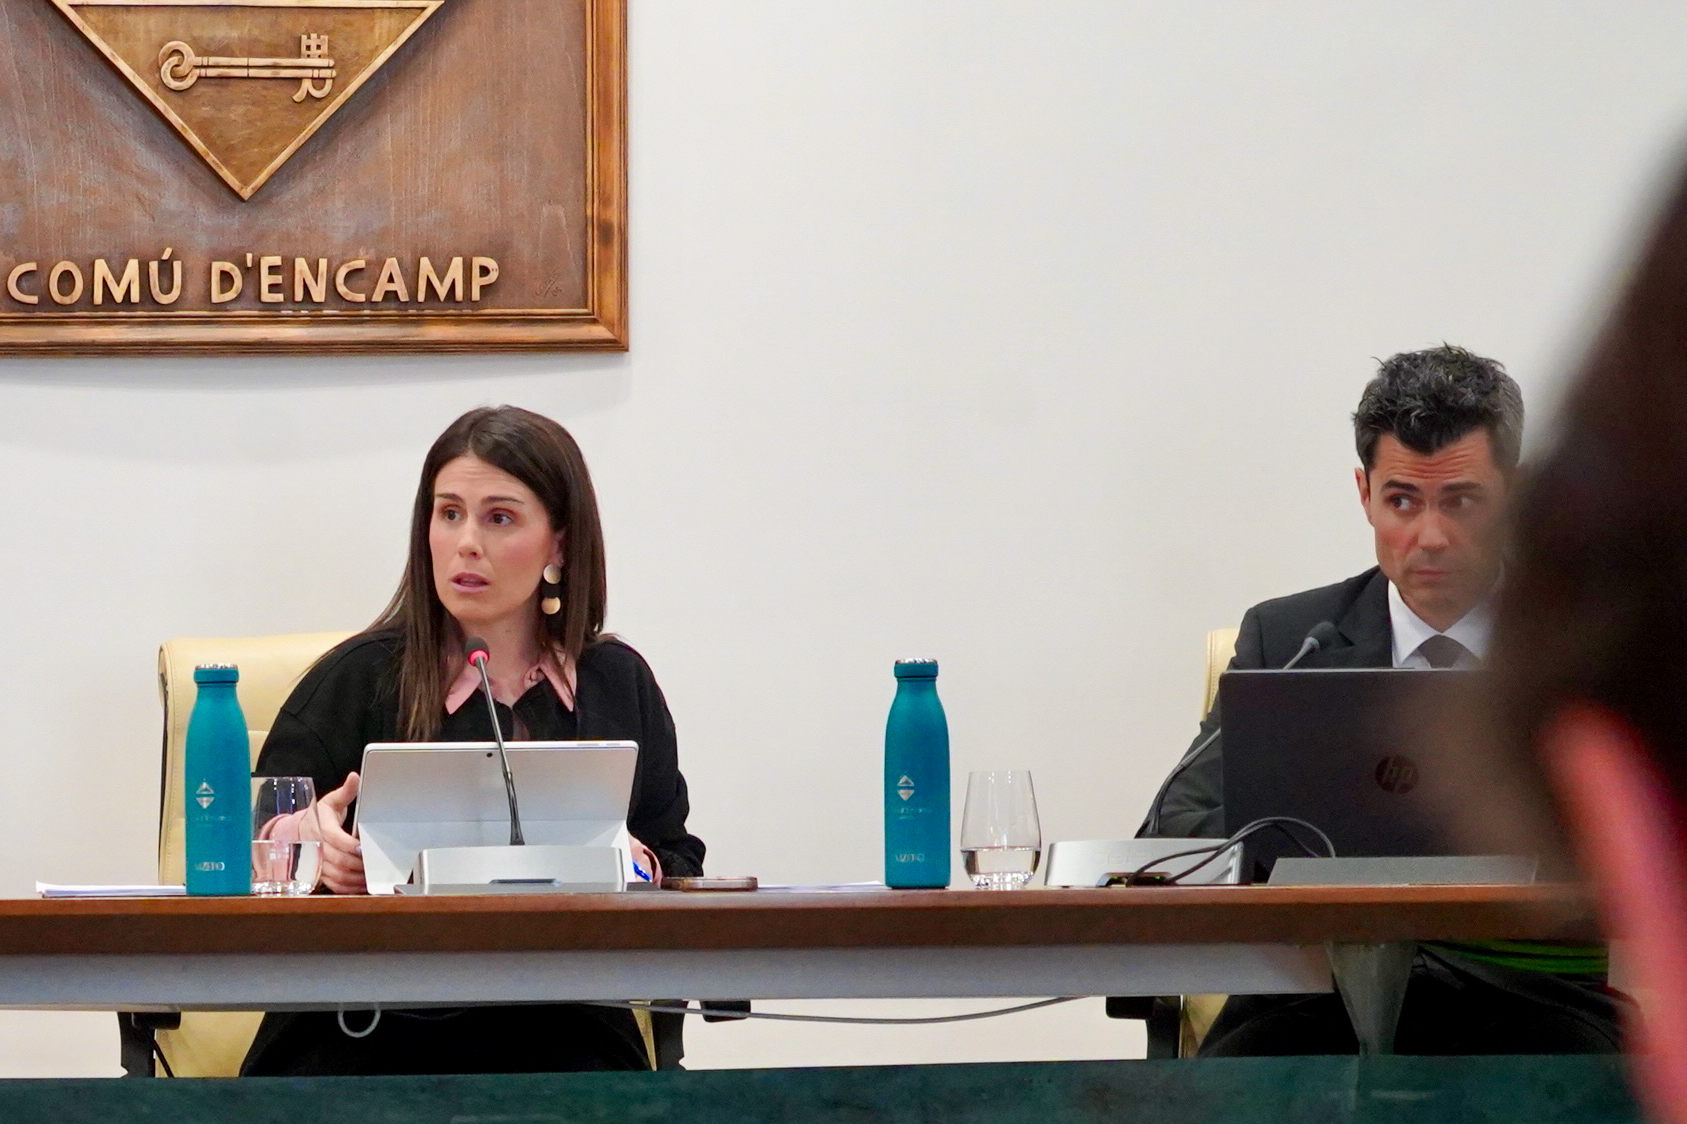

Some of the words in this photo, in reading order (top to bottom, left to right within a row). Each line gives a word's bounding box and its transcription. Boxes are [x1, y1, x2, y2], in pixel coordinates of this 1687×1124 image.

[6, 247, 182, 306] COMÚ
[210, 253, 500, 304] D'ENCAMP
[1381, 757, 1414, 793] hp
